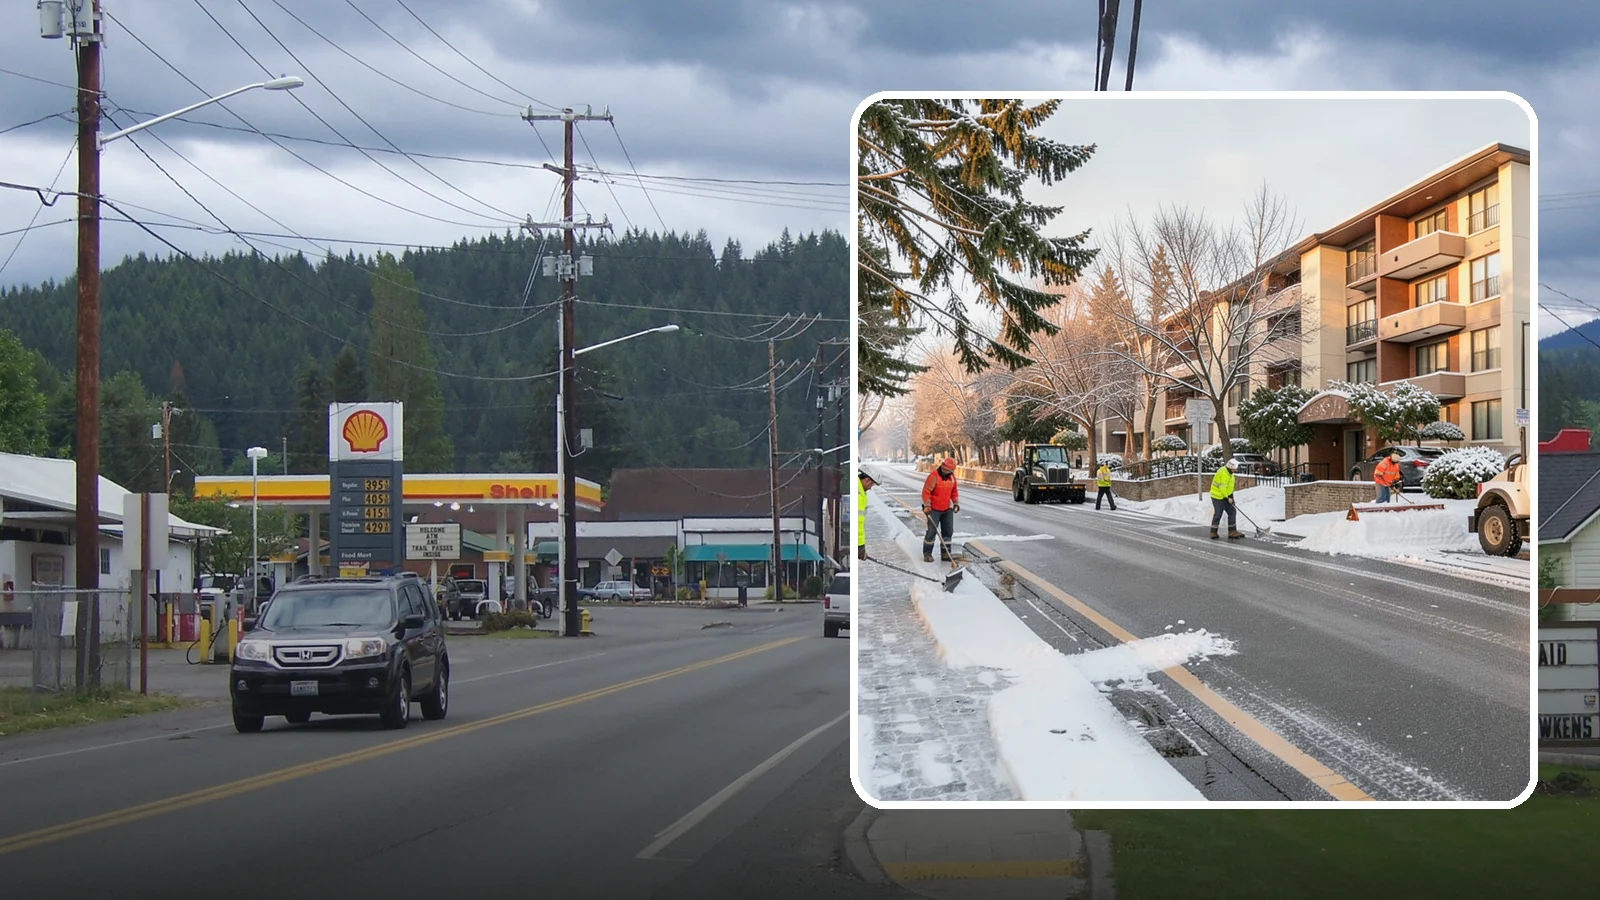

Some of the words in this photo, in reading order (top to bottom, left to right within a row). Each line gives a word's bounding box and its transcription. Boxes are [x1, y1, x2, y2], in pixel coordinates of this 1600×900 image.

[365, 480, 383, 490] 395
[490, 484, 547, 499] Shell
[365, 494, 383, 504] 405
[365, 508, 383, 518] 415
[365, 522, 383, 532] 429
